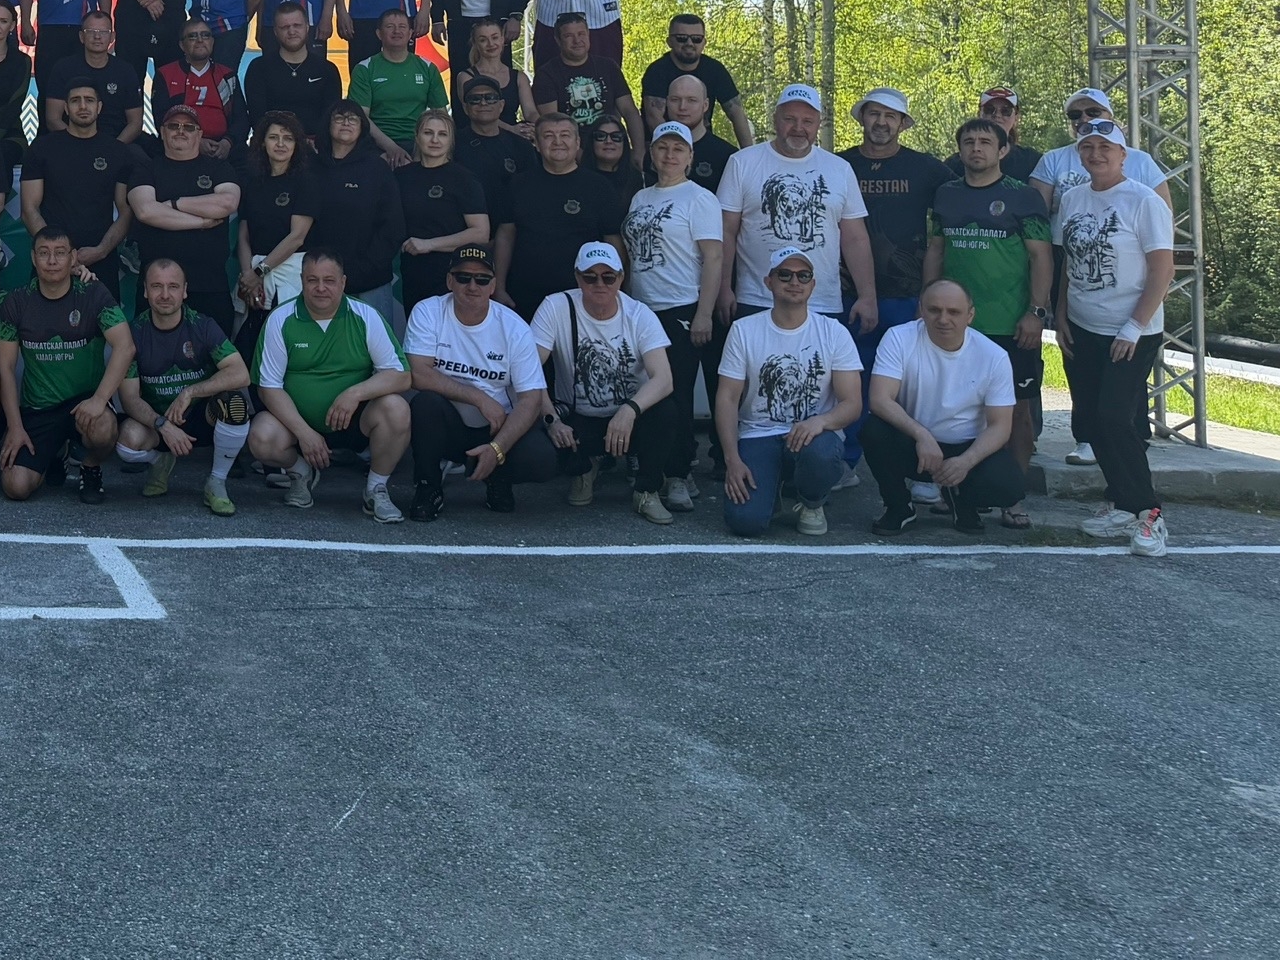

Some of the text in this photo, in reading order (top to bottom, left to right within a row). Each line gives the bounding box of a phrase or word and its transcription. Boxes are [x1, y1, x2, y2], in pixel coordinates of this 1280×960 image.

[575, 109, 593, 117] JUST
[860, 179, 909, 194] GESTAN
[979, 228, 1007, 239] ПАЛАТА
[459, 248, 486, 259] СССР
[63, 338, 88, 350] ПАЛАТА
[35, 353, 75, 361] ХМАО-ЮГРЫ
